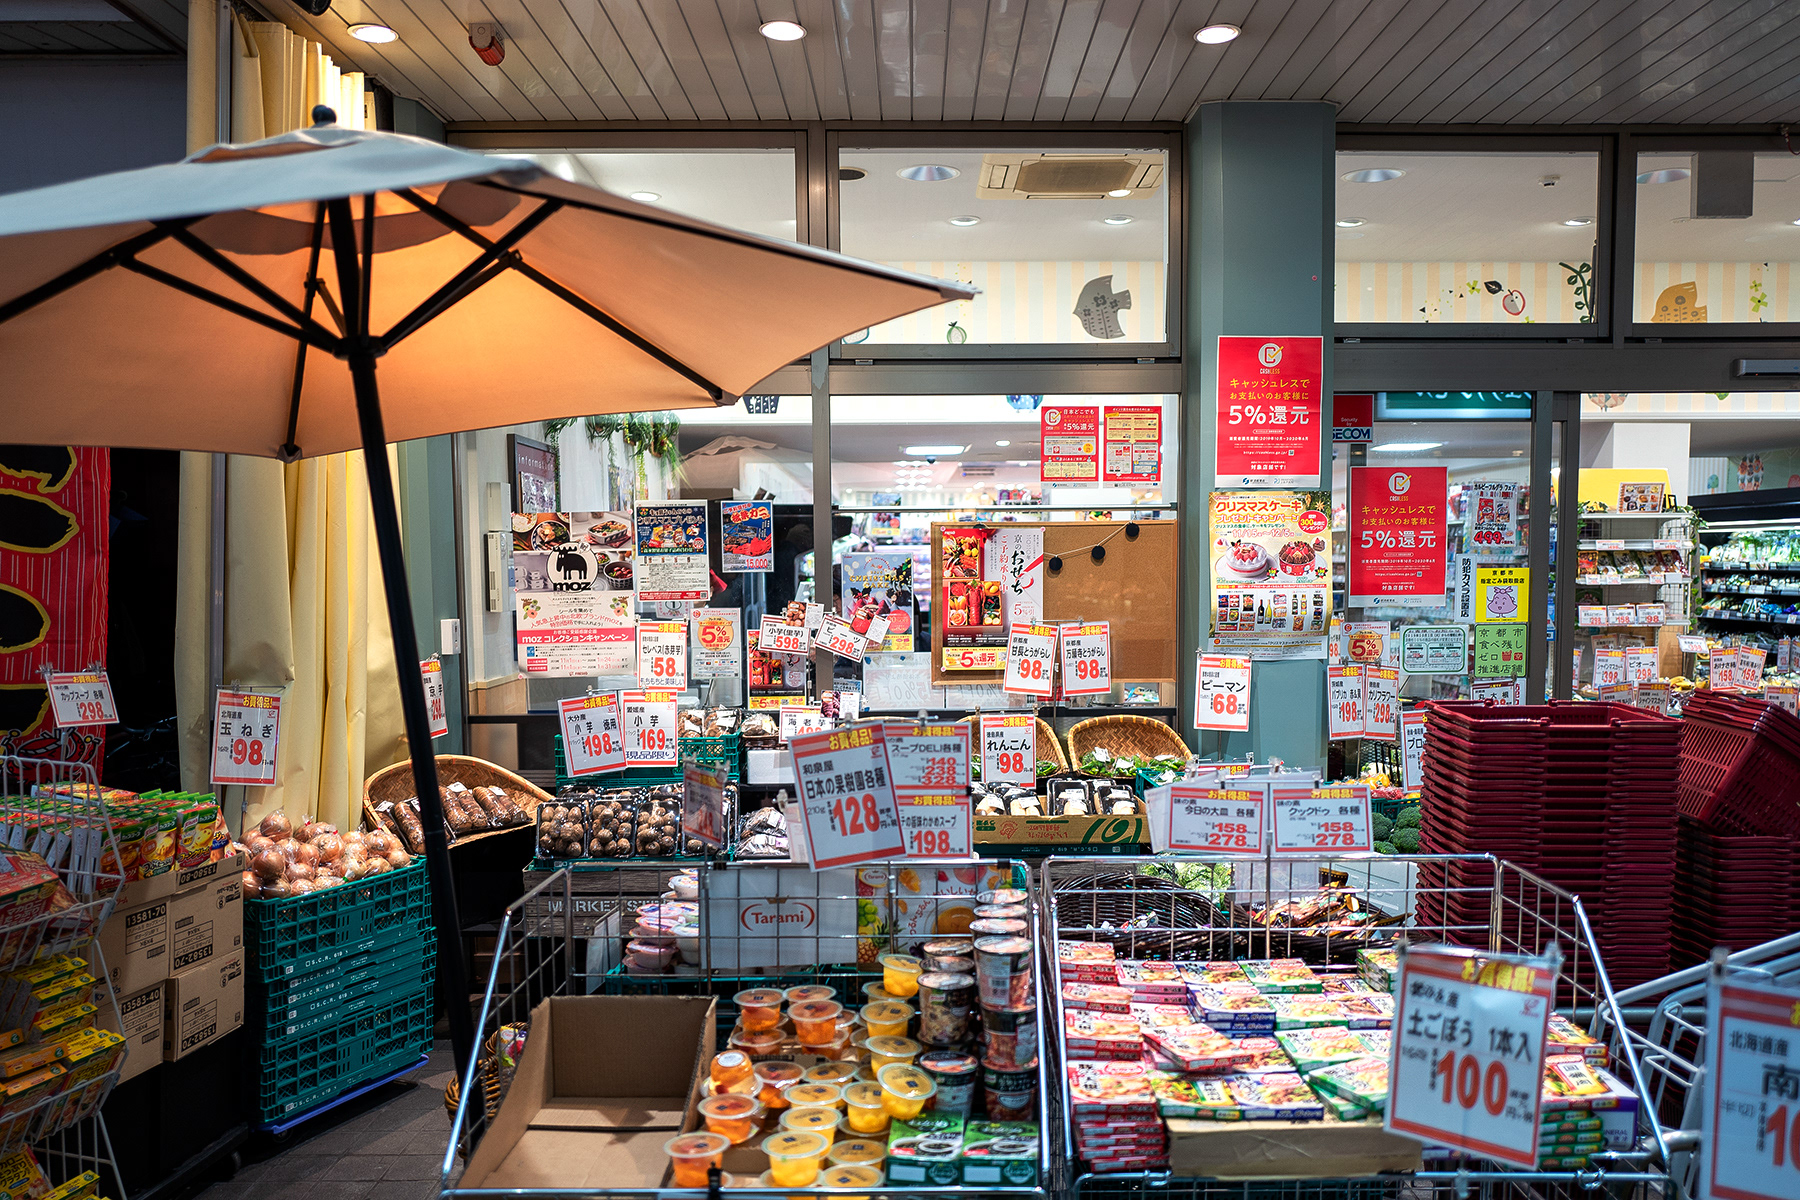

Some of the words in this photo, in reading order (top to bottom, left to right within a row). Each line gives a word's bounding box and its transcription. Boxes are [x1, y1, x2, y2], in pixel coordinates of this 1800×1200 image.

[1230, 379, 1310, 389] キャッシュレスで
[1230, 392, 1309, 400] お支払いのお客様に
[1228, 405, 1310, 425] 5%還元
[1215, 500, 1302, 512] クリスマスケーキ
[1361, 505, 1437, 515] キャッシュレスで
[1215, 514, 1299, 523] プレゼントキャンペーン
[1361, 518, 1436, 526] お支払いのお客様に
[1361, 530, 1437, 549] 5%還元
[1473, 531, 1501, 544] 499
[1000, 534, 1009, 594] ご予約承り中
[849, 574, 904, 582] CHRISTMAS
[553, 582, 591, 591] moz
[1461, 558, 1471, 617] 防犯カメラ設置店
[657, 624, 681, 633] お買得品!
[701, 625, 727, 643] 5%
[768, 627, 804, 637] 小芋(里芋)
[1029, 626, 1052, 636] お買得品!
[1080, 626, 1103, 636] お買得品!
[1478, 628, 1523, 637] 京都市
[544, 634, 629, 643] コレクションキャンペーン
[775, 635, 800, 650] 598
[1479, 640, 1523, 649] 食べ残し
[642, 645, 684, 655] セレベス(赤芽芋)
[829, 635, 855, 655] 298
[1351, 639, 1377, 657] 5%
[1011, 646, 1050, 659] 甘長とうがらし
[1065, 647, 1105, 659] 万願寺とうがらし
[1479, 652, 1498, 661] ゼロ
[653, 657, 676, 677] 58
[1020, 659, 1043, 680] 98
[1077, 659, 1100, 680] 98
[1478, 664, 1523, 674] 推進店舗
[1636, 668, 1652, 680] 298
[1719, 670, 1732, 682] 158
[1742, 668, 1756, 681] 158
[1202, 680, 1246, 692] ピーマン
[61, 691, 90, 701] カップスープ
[242, 696, 272, 708] お買得品!
[584, 696, 610, 708] お買得品!
[644, 692, 670, 702] お買得品!
[1368, 690, 1396, 702] カリフラワー
[1213, 693, 1238, 715] 68
[80, 701, 104, 720] 298
[221, 711, 242, 719] 北海道産
[1341, 701, 1357, 722] 198
[1374, 702, 1390, 723] 298
[568, 714, 586, 722] 大分産
[1003, 718, 1028, 727] お買得品!
[220, 722, 274, 738] 玉ねぎ
[602, 718, 617, 731] 徳用
[912, 727, 956, 736] お買得品!
[584, 732, 613, 757] 198
[640, 729, 666, 750] 169
[829, 728, 873, 750] お買得品!
[986, 739, 1031, 751] れんこん
[233, 738, 263, 766] 98
[892, 744, 962, 753] スープDELI各種
[626, 751, 676, 760] 現品限り
[802, 760, 834, 775] 和泉屋
[999, 752, 1024, 774] 98
[926, 766, 956, 776] 238
[805, 766, 886, 799] 日本の果樹園各種
[922, 776, 956, 785] 328
[1208, 790, 1250, 800] お買得品!
[1310, 789, 1354, 798] お買得品!
[913, 796, 956, 805] お買得品!
[832, 793, 880, 836] 128
[1185, 806, 1228, 816] 今日の大皿
[1236, 808, 1256, 818] 各種
[1288, 807, 1330, 816] クックドゥ
[1338, 806, 1360, 816] 各種
[1214, 822, 1247, 833] 158
[1320, 822, 1354, 832] 158
[914, 830, 950, 854] 198
[1208, 834, 1247, 846] 278
[1315, 833, 1355, 846] 278
[181, 866, 216, 882] 13580-80
[548, 900, 618, 912] MRKE
[127, 906, 166, 926] 13581-70
[750, 910, 804, 925] Tarami
[175, 947, 212, 968] 13582-70
[122, 990, 160, 1013] 13583-40
[1407, 1008, 1472, 1048] 土ごぼう
[183, 1024, 216, 1050] 13582-70
[1489, 1027, 1532, 1062] 1本入
[1729, 1030, 1790, 1057] 北海道産
[1437, 1050, 1508, 1116] 100
